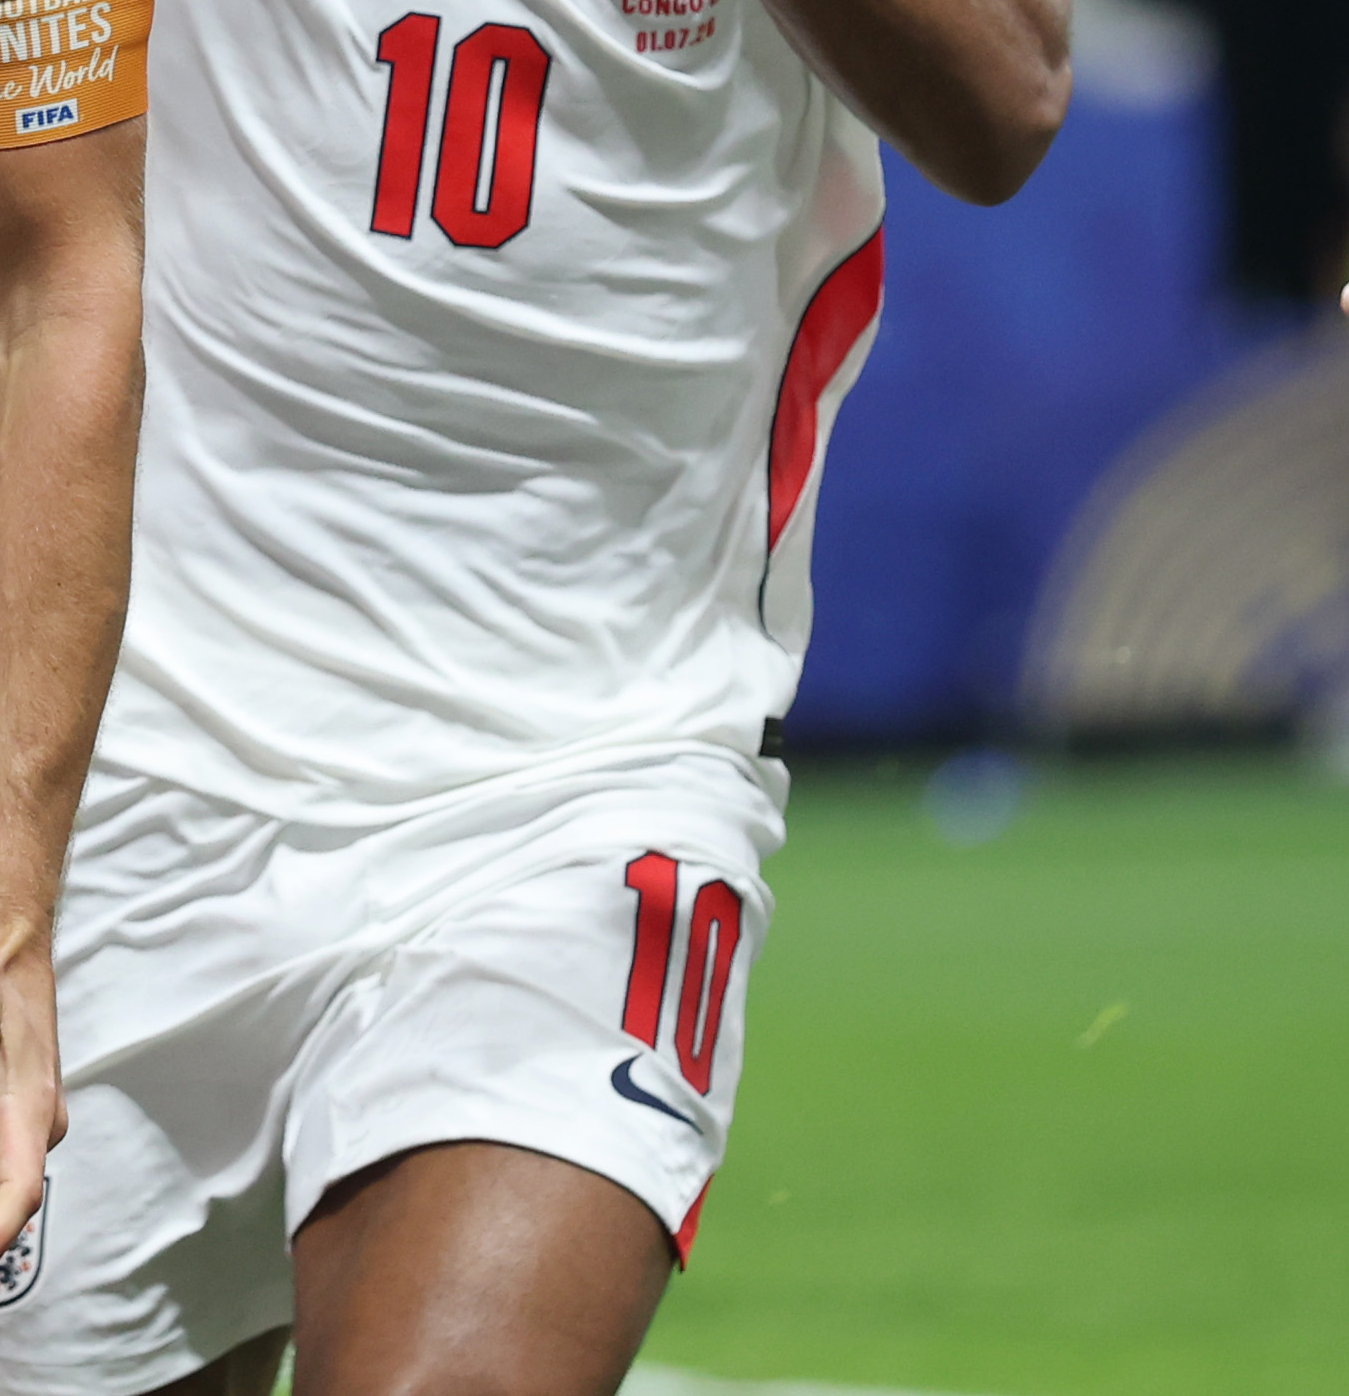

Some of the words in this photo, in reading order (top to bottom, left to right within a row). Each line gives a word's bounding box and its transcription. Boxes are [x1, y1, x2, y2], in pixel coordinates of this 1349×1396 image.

[22, 104, 75, 130] FIFA
[28, 45, 120, 99] World
[369, 11, 552, 249] 10
[621, 849, 744, 1097] 10
